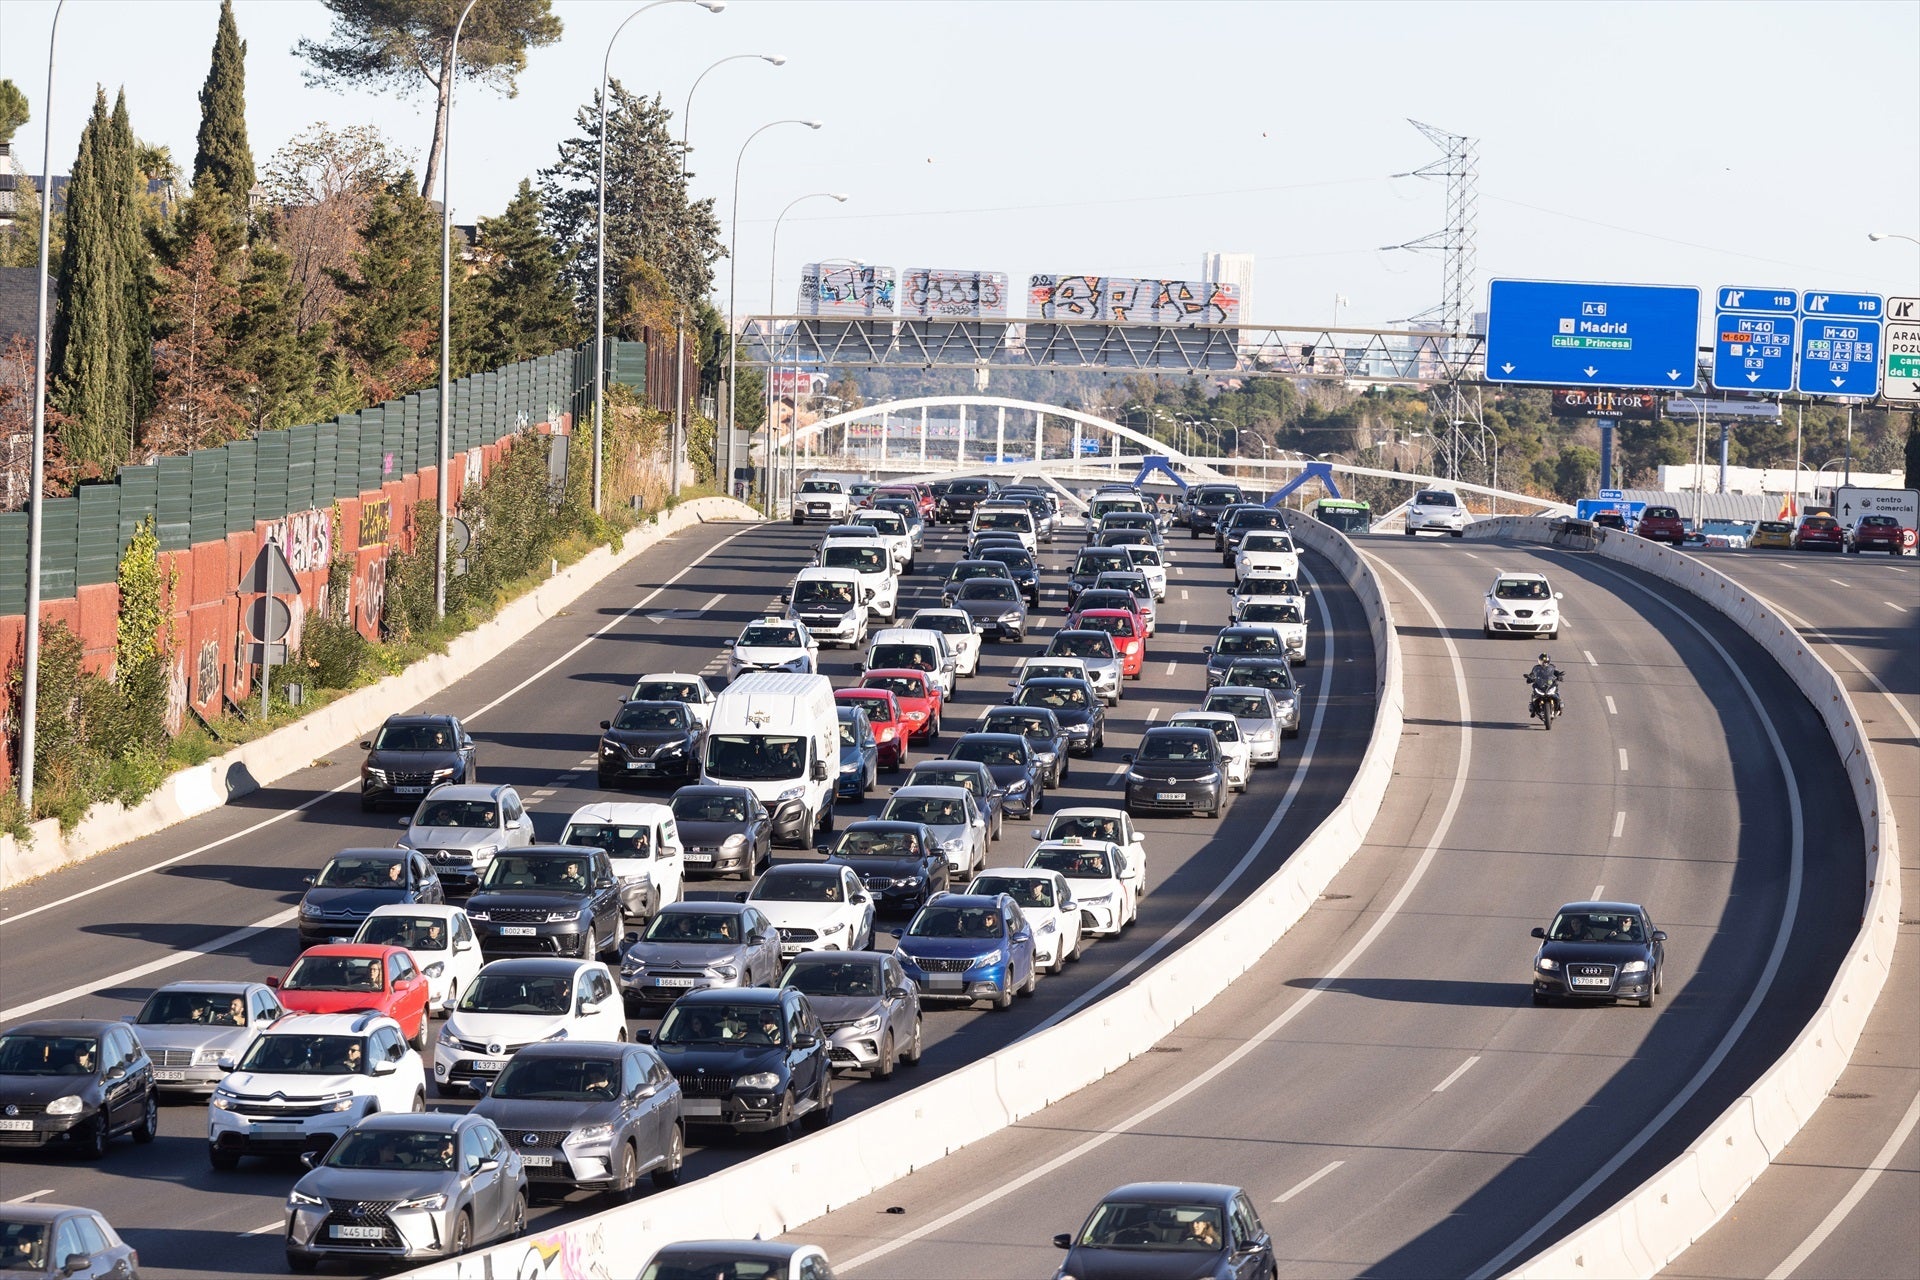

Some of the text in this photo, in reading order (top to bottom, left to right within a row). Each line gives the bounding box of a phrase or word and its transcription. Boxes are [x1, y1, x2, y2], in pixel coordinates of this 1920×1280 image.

[1773, 296, 1791, 306] 11B
[1858, 301, 1876, 311] 11B
[1585, 304, 1604, 314] A-6
[1580, 321, 1628, 334] Madrid
[1741, 321, 1771, 332] M-40
[1722, 333, 1788, 344] M-607 A-1 R-2
[1825, 328, 1856, 339] M-40
[1554, 337, 1630, 348] calle Princesa
[1809, 341, 1871, 351] E-90 A-5 R-5
[1764, 347, 1779, 356] A-2
[1808, 350, 1871, 361] A-42 A-4 R-4
[1746, 359, 1762, 367] R-3
[1831, 363, 1847, 371] A-3
[1889, 368, 1920, 377] del B
[1565, 394, 1642, 408] GLADIATOR
[1876, 496, 1902, 504] centro
[1876, 504, 1914, 513] comercial
[748, 715, 771, 724] RENÉ
[505, 927, 521, 935] 6002
[478, 1061, 497, 1070] 4373
[15, 1121, 31, 1130] FYZ
[535, 1156, 551, 1165] JTR
[362, 1228, 380, 1238] LCJ
